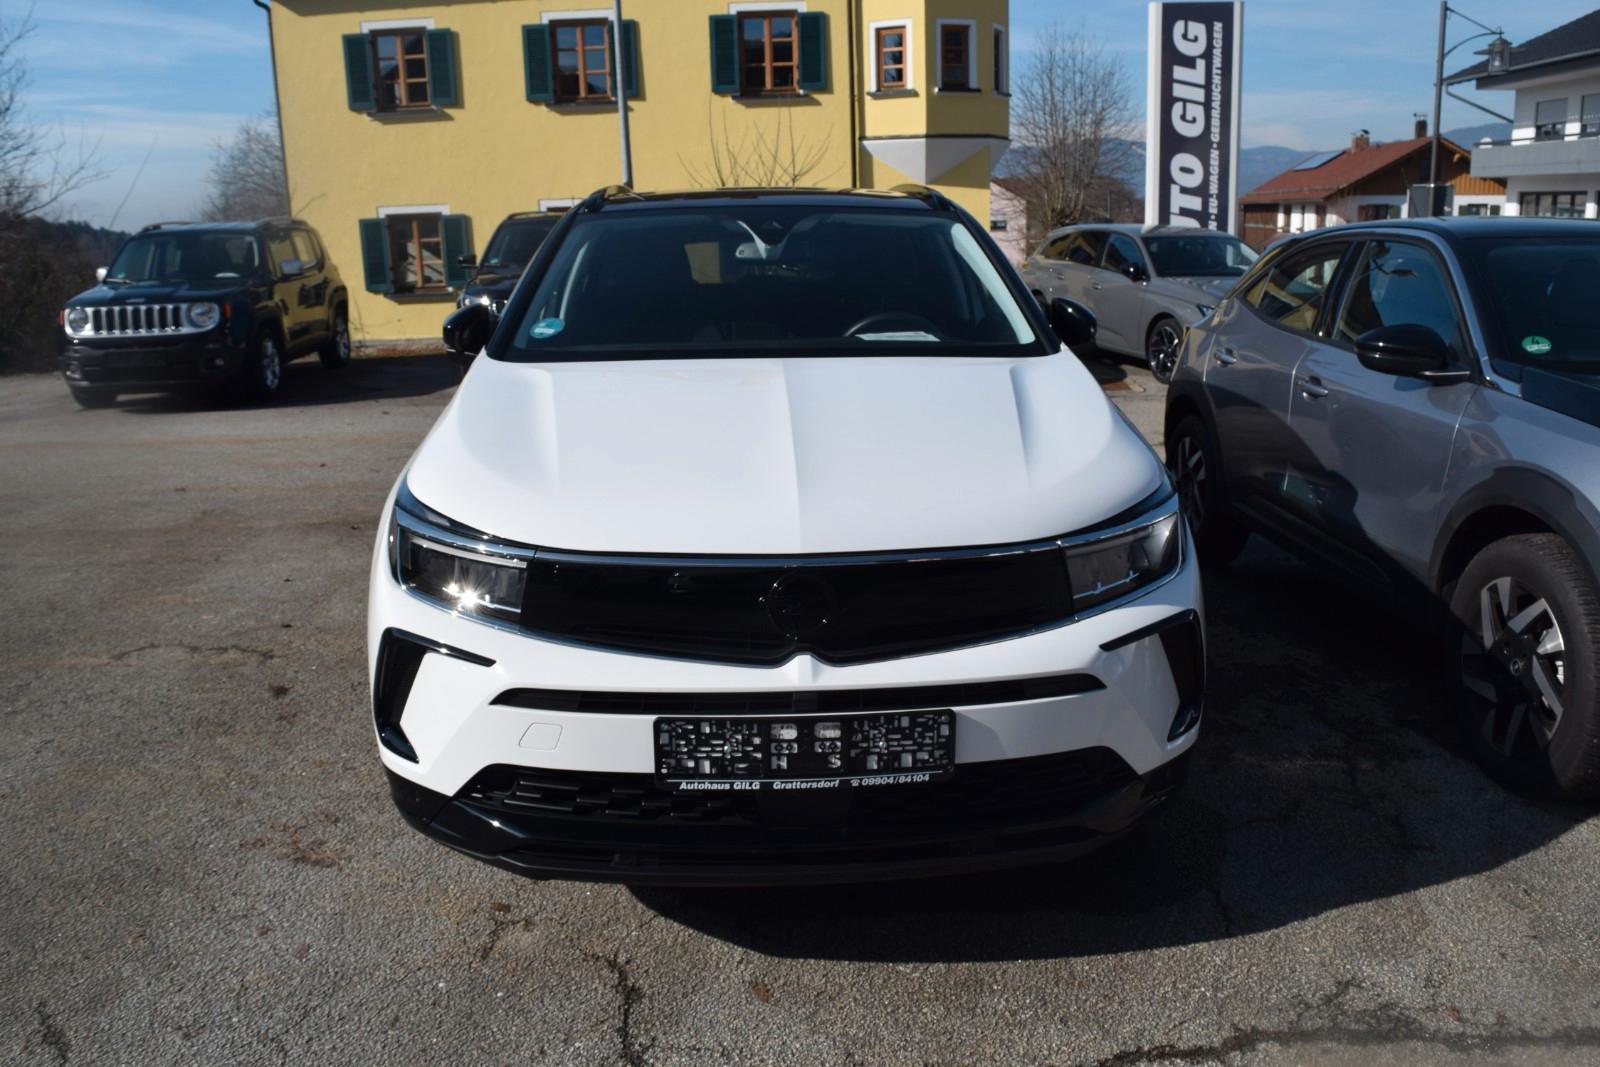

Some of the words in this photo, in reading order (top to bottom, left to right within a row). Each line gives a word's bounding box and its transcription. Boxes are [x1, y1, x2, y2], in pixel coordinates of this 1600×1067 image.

[1171, 20, 1207, 138] GILG
[1211, 22, 1223, 142] GEBRAUCHTWAGEN
[1208, 149, 1220, 215] EU-WAGEN
[680, 782, 730, 790] Autohaus
[733, 782, 761, 790] GILG
[772, 780, 839, 790] Grattersdorf
